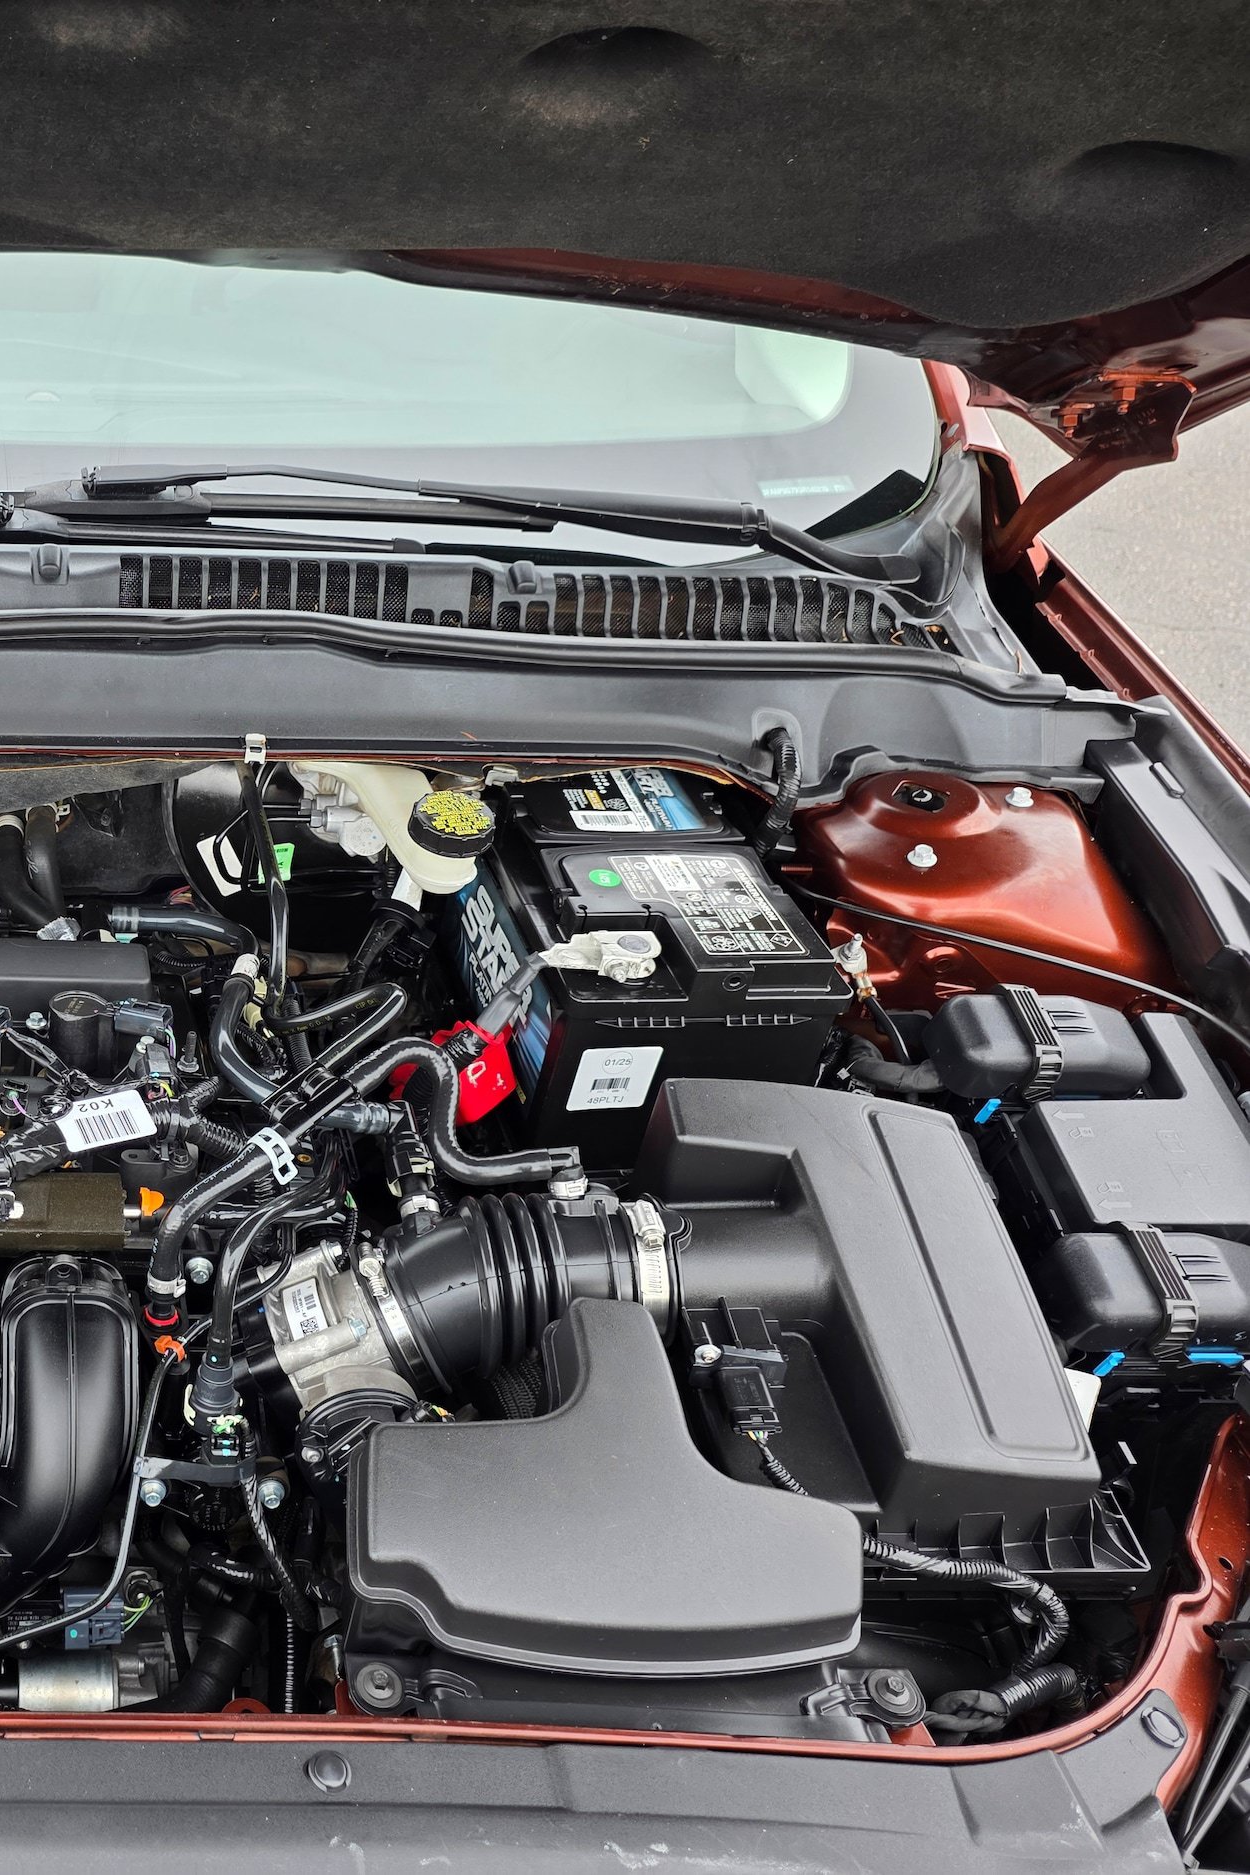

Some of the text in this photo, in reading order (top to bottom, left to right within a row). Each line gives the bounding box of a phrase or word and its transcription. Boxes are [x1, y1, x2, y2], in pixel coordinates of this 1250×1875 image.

[604, 1058, 632, 1067] 01/25
[586, 1095, 625, 1104] 48PLTJ
[77, 1098, 114, 1113] K02
